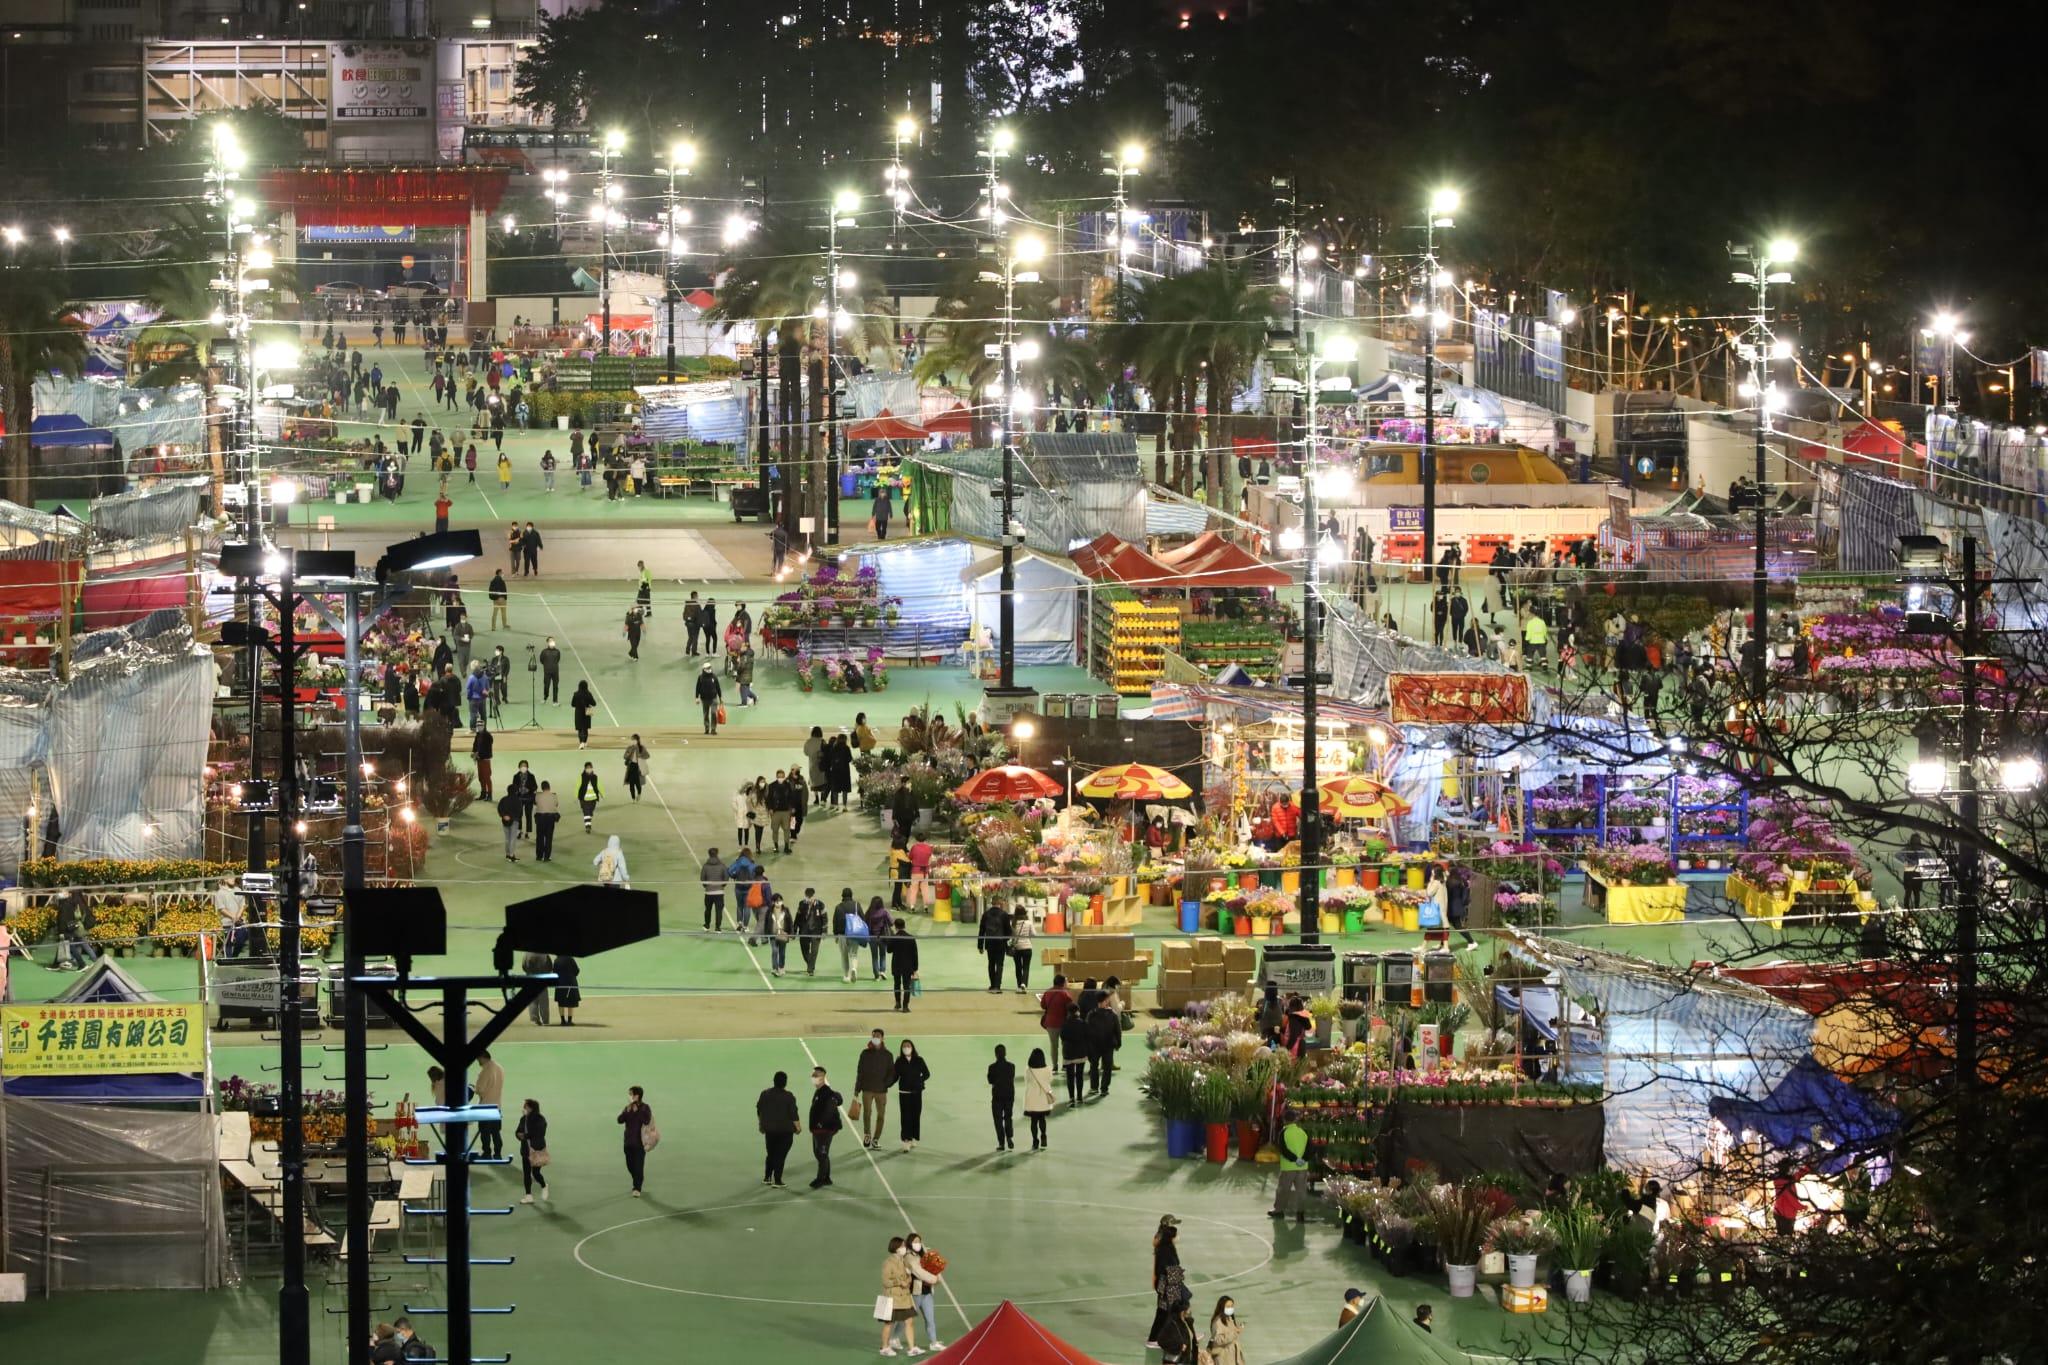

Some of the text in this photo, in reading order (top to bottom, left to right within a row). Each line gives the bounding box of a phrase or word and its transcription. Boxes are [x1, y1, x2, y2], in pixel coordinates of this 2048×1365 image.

[335, 225, 374, 234] NO EXIT
[37, 1018, 188, 1051] 千葉園有限公司
